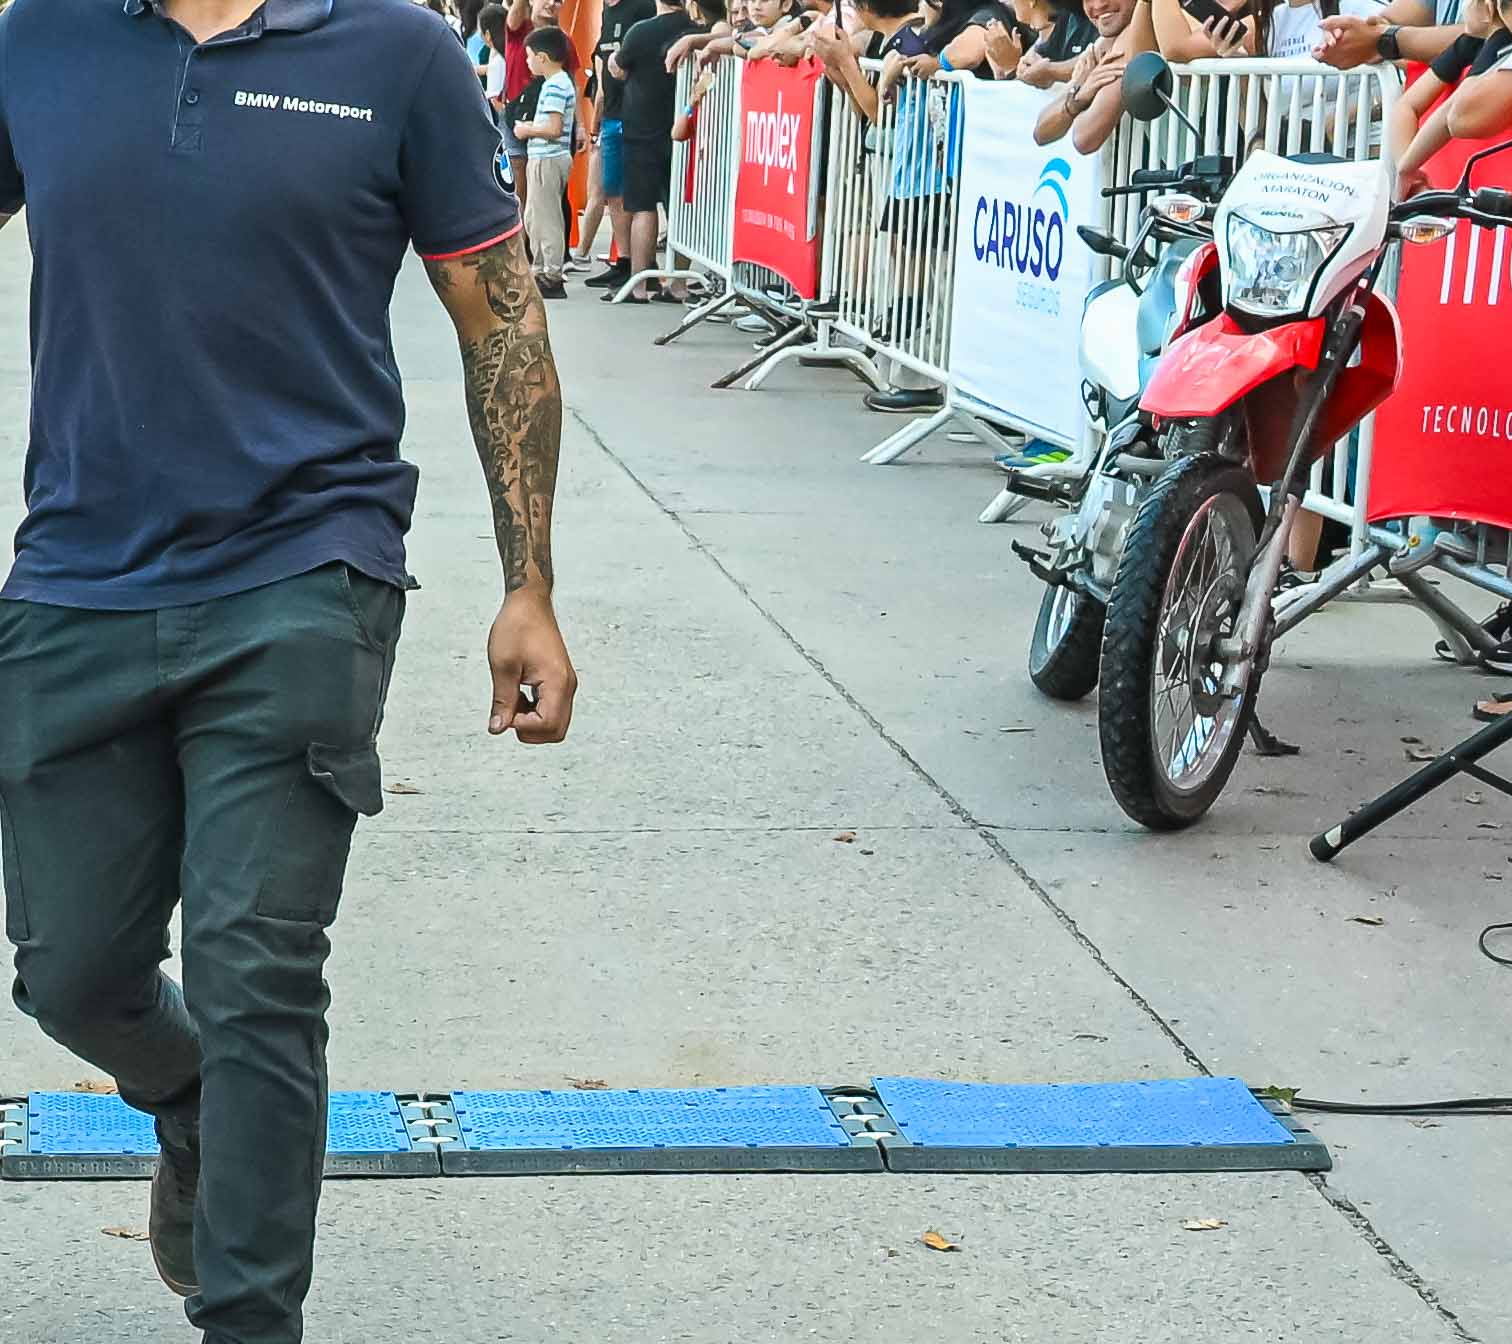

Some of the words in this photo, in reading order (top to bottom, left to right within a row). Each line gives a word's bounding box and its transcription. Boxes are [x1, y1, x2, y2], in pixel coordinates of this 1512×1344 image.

[234, 90, 280, 109] BMW
[282, 96, 373, 122] Motorsport
[744, 90, 801, 187] moplex
[973, 195, 1064, 282] CARUSO
